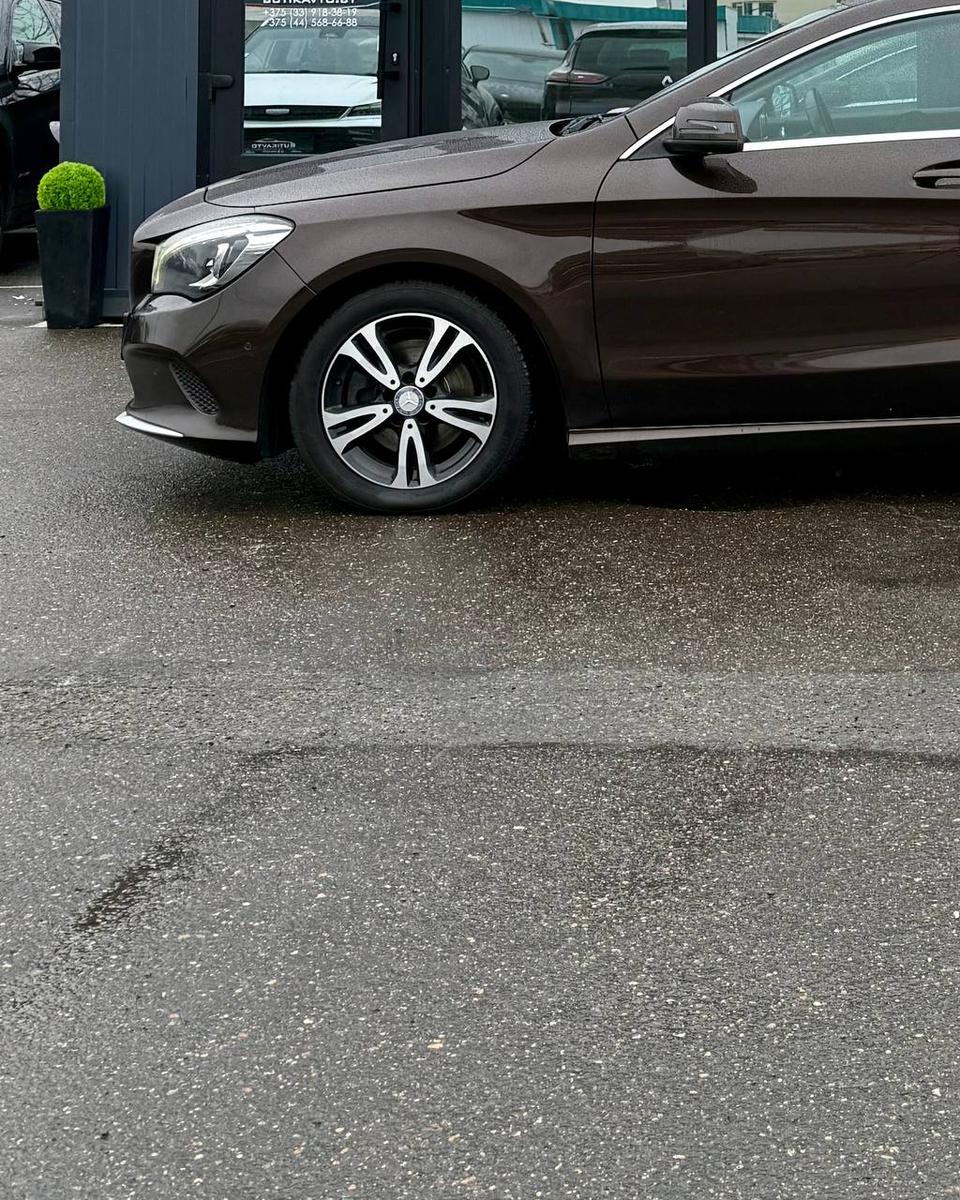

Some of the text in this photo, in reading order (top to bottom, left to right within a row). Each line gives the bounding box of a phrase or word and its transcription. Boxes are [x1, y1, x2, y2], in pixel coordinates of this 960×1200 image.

[264, 7, 357, 18] +375 (33) 918-38-19
[263, 17, 358, 29] 375 (44) 568-66-88
